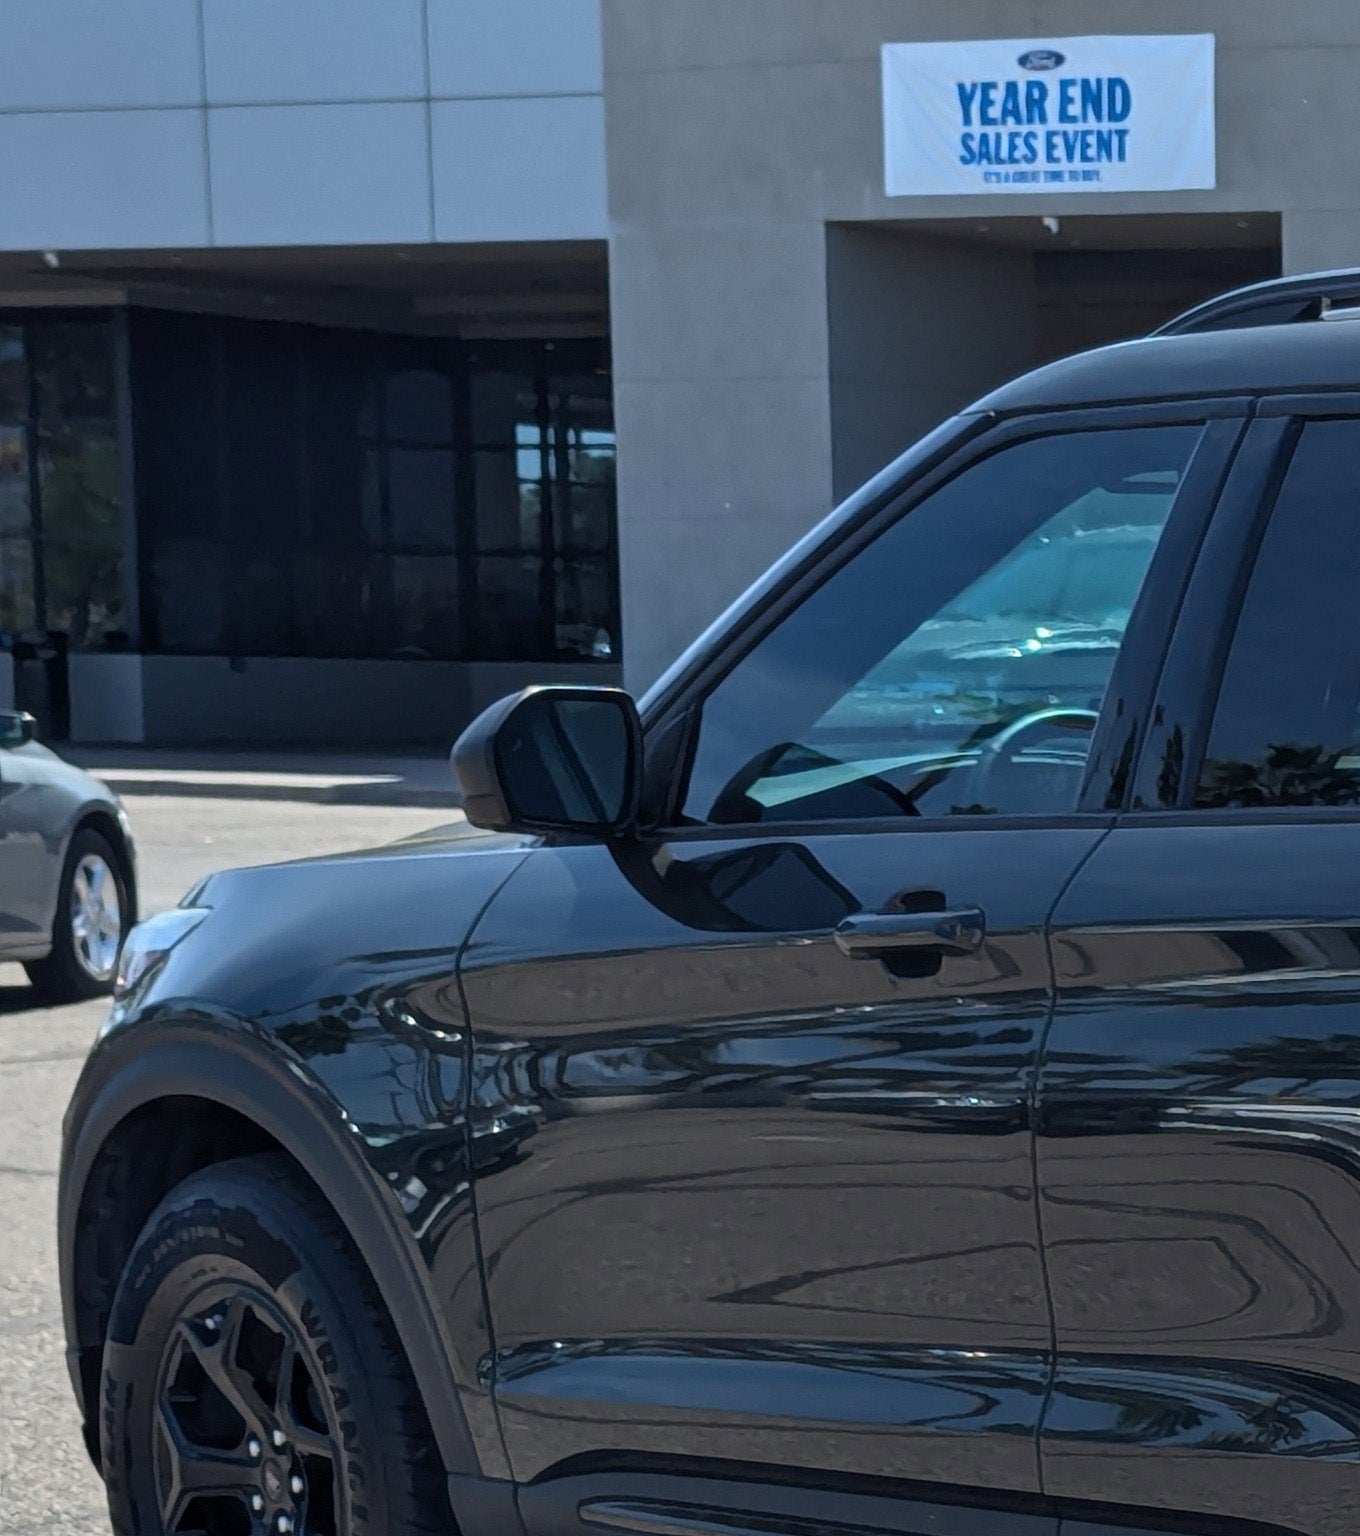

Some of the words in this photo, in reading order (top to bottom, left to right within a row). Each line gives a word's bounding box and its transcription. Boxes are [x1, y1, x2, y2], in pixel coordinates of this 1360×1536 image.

[957, 80, 1049, 126] YEAR
[1058, 77, 1132, 124] END
[959, 130, 1038, 165] SALES
[1045, 128, 1130, 164] EVENT
